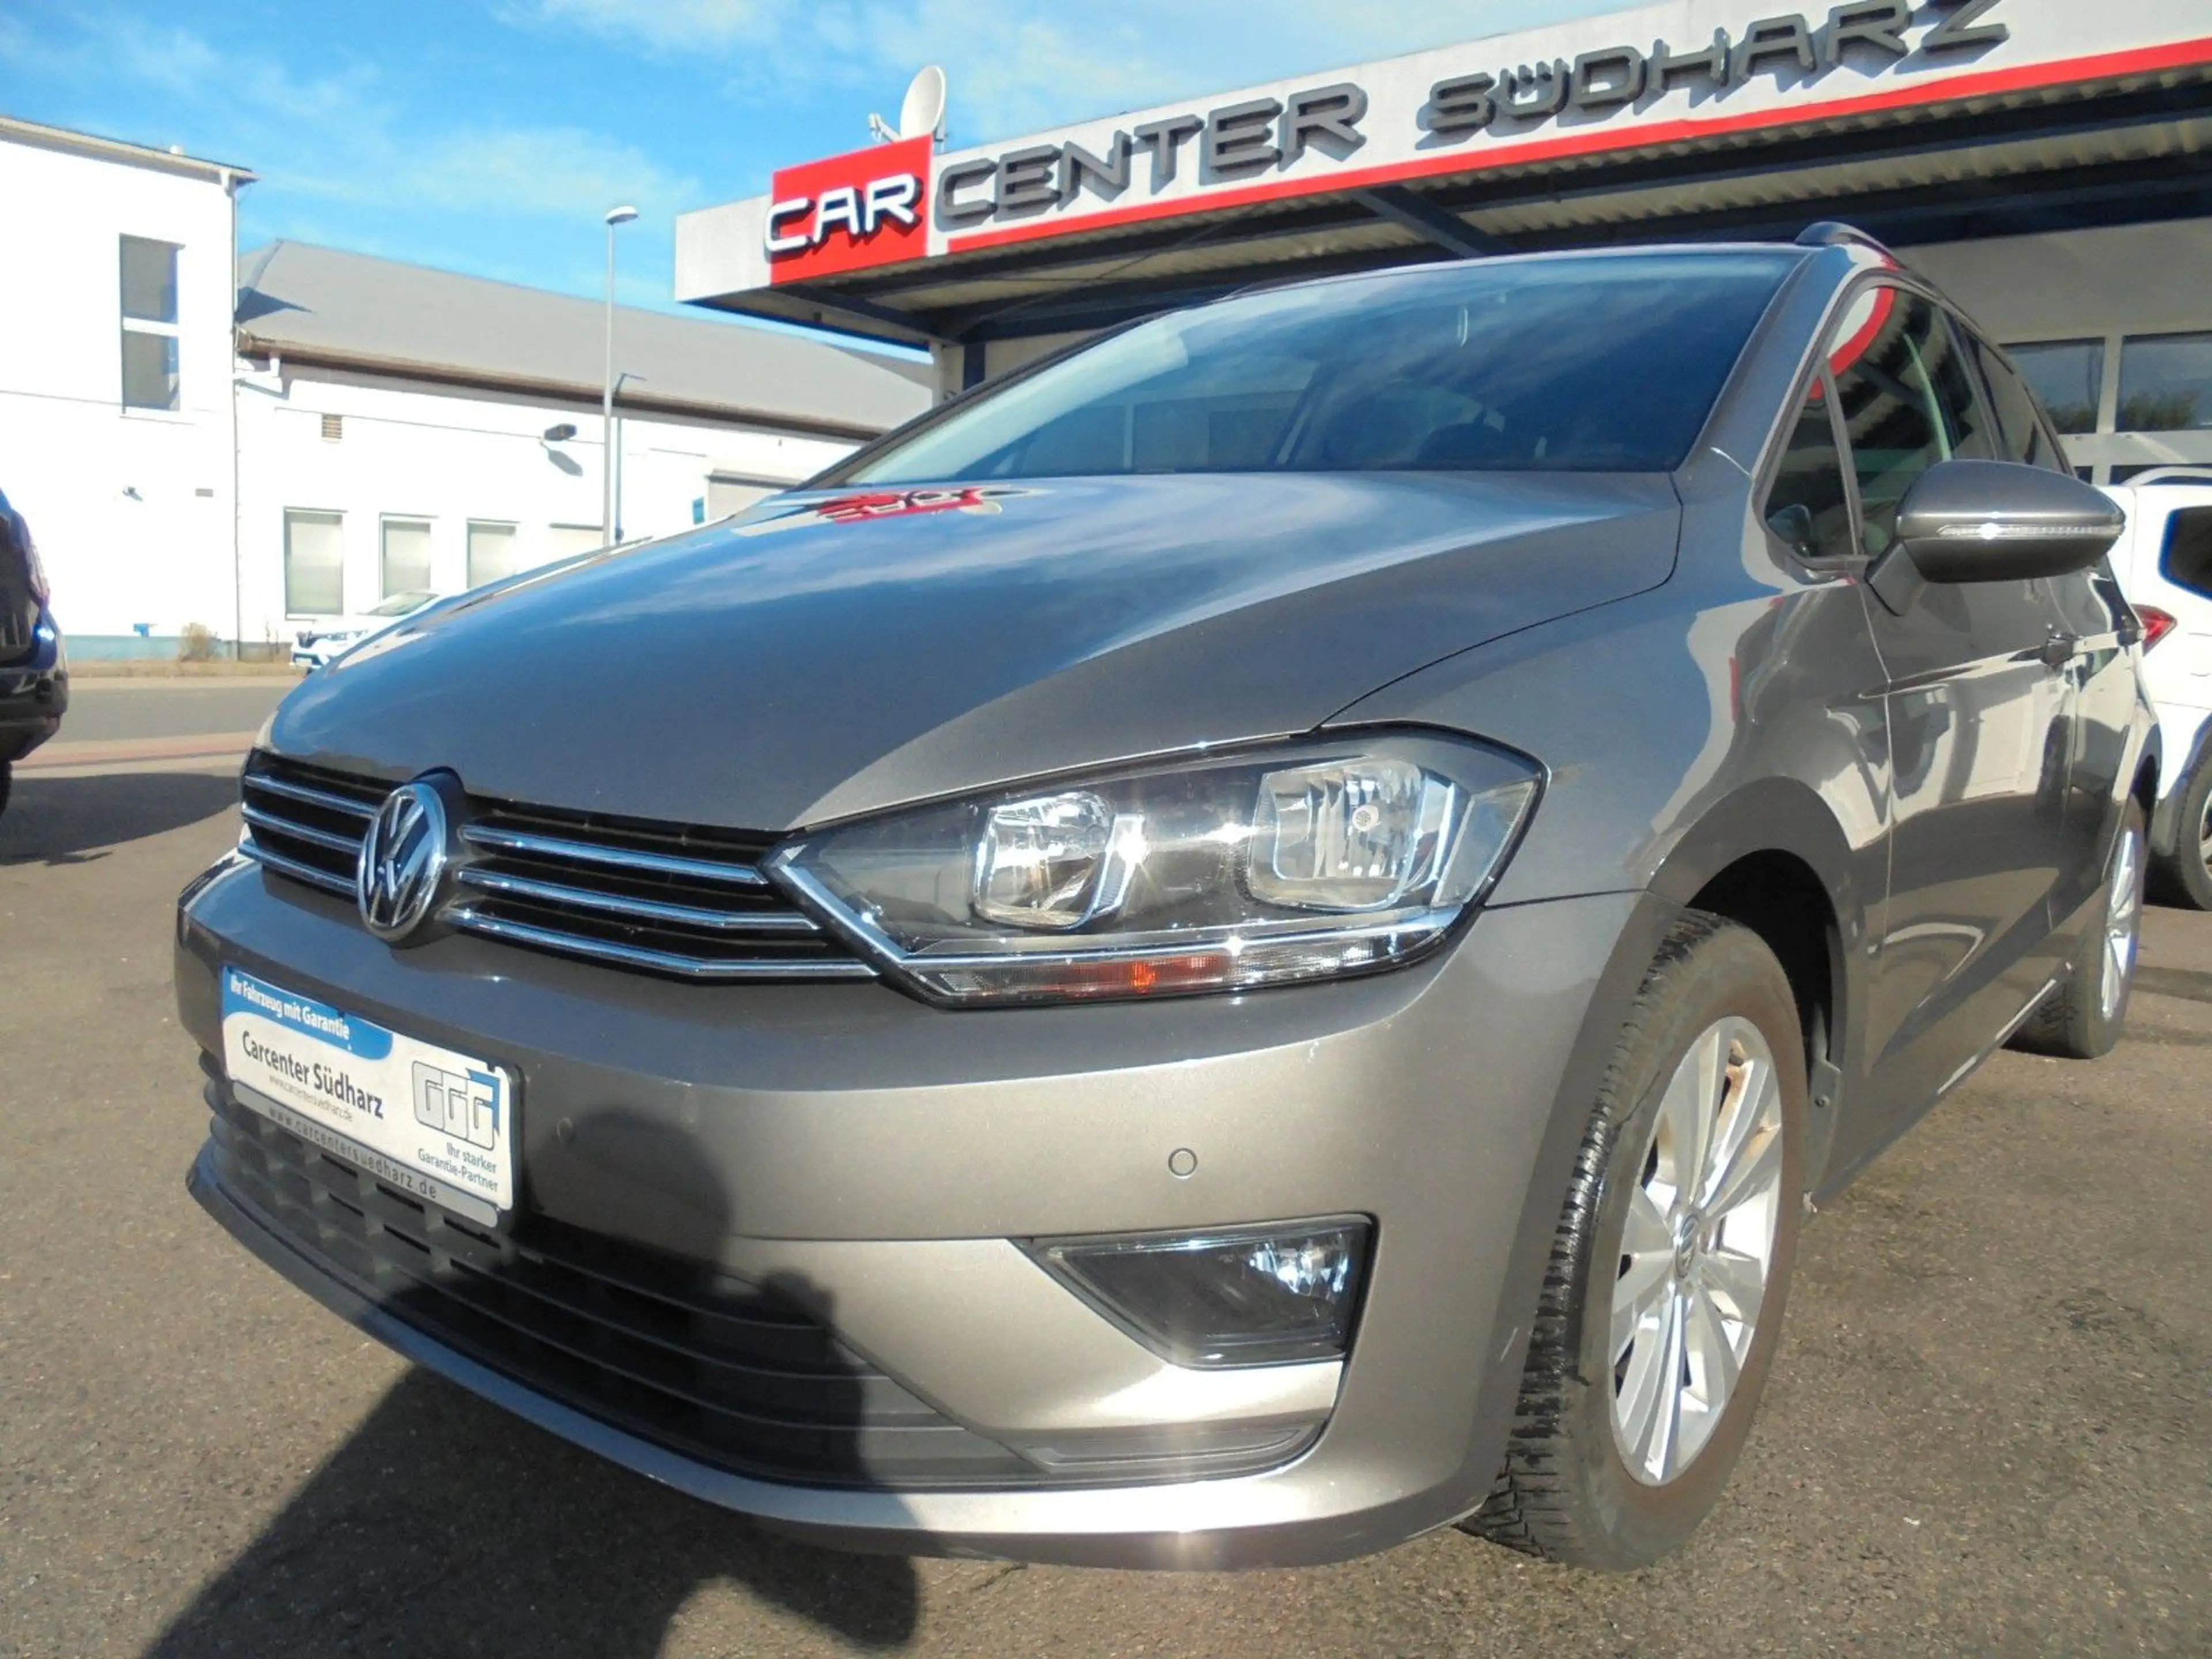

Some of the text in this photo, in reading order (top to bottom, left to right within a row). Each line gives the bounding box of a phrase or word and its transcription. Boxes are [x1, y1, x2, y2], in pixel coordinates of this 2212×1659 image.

[764, 0, 2010, 253] CAR CENTER SÜDHARZ
[230, 974, 350, 1040] Ihr Fahrzeug mit Garantie
[242, 1031, 384, 1120] Carcenter Südharz
[268, 1106, 438, 1200] www.carcentersuedharz.de
[418, 1147, 498, 1192] Garantie-Partner
[446, 1142, 497, 1174] Ihr starker
